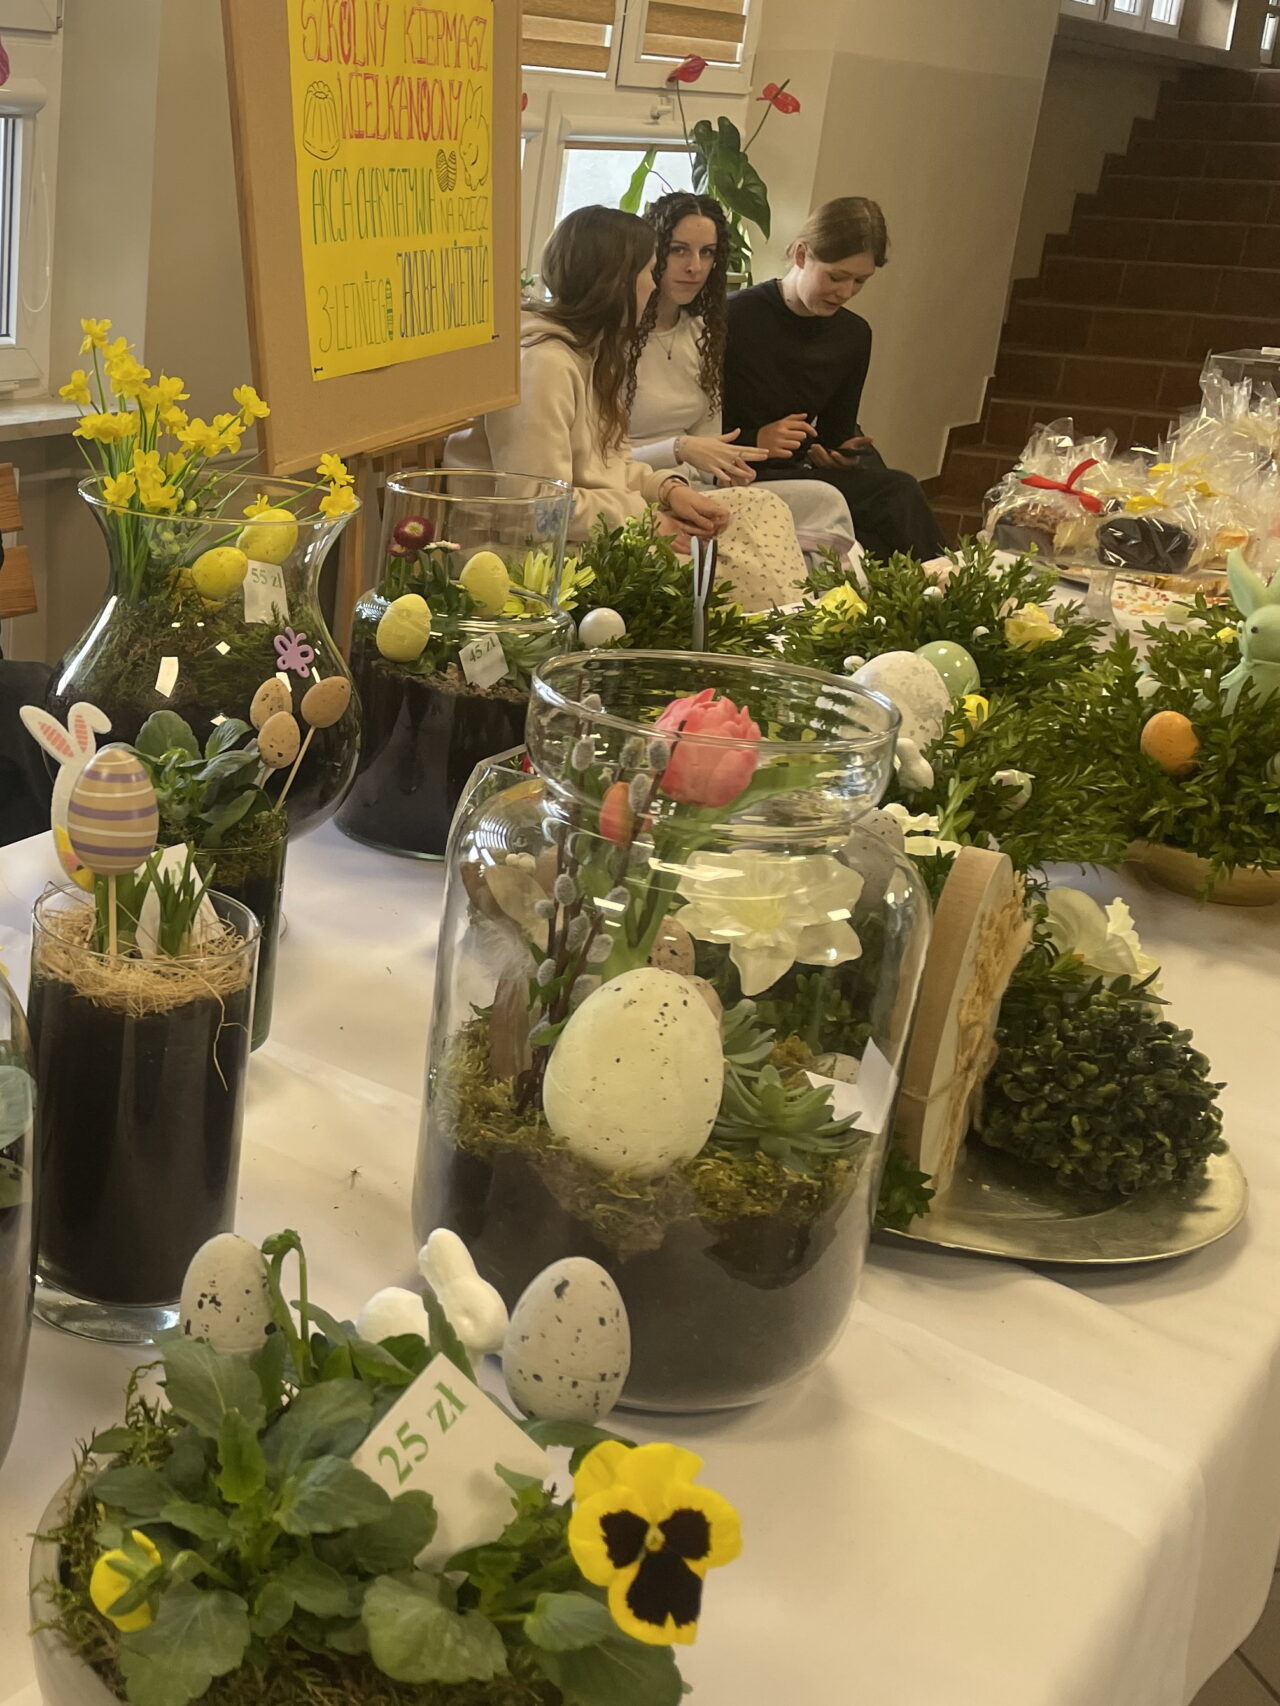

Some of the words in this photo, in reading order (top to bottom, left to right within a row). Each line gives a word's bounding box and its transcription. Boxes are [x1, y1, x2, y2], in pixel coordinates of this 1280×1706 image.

[300, 0, 389, 67] SZKOLNY
[403, 3, 488, 72] KIERMASZ
[336, 69, 463, 142] WIELKANOCNY
[311, 167, 354, 245] AKCJA
[356, 167, 437, 240] CHARYTATYWNA
[396, 248, 439, 338] JAKUBA
[440, 236, 489, 332] KWIETNIA
[251, 567, 268, 585] 55
[377, 1420, 429, 1487] 25
[427, 1381, 468, 1435] zł
